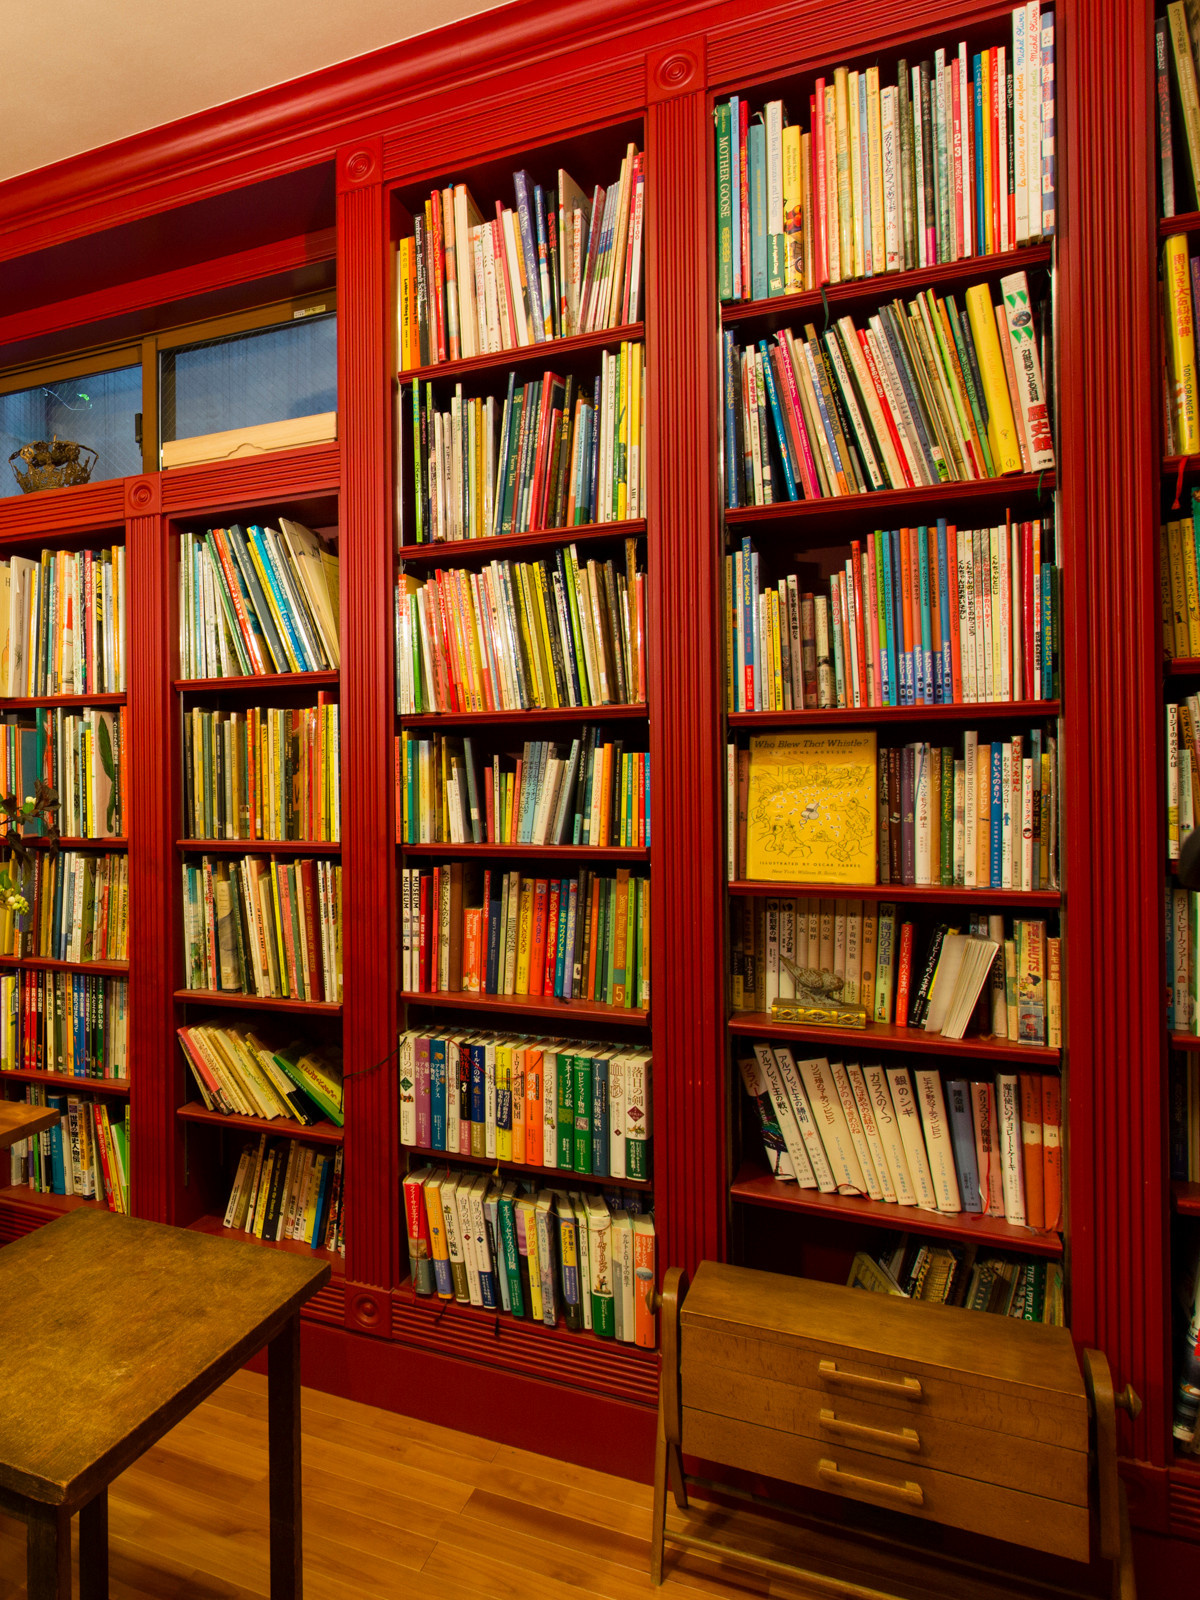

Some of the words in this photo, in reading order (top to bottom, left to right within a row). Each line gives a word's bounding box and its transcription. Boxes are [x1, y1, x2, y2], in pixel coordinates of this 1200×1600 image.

[719, 136, 729, 182] MOTHER
[720, 184, 731, 218] GOOSE
[413, 216, 422, 245] Rembrandt
[414, 253, 424, 283] Rembrandt
[1173, 253, 1191, 338] 思いつき大百科辞典
[810, 337, 820, 357] PETER
[817, 363, 828, 387] HUNT'S
[824, 394, 841, 436] WORKBOOK
[1183, 364, 1194, 416] 100%ORANGE
[1028, 404, 1053, 452] 歴史館
[754, 740, 775, 748] Who
[778, 739, 800, 748] Blew
[803, 739, 825, 748] That
[827, 738, 869, 748] Whistle?
[1169, 707, 1177, 767] ロージーのおさんぽ
[992, 752, 1001, 805] ももいろのきりん
[1012, 740, 1021, 793] わんぱくえほん
[617, 894, 627, 913] Seeing
[785, 913, 794, 953] 少女ソフィアの夏
[880, 921, 892, 966] 海辺の王国
[1028, 923, 1040, 972] PEANUTS
[615, 986, 623, 1001] 5
[564, 1058, 573, 1107] アネイリンの歌
[632, 1066, 643, 1106] 落日の剣
[834, 1069, 850, 1098] イタリアの
[843, 1099, 861, 1135] のぞきめがね
[870, 1072, 892, 1124] ガラスのくつ
[894, 1075, 914, 1118] 銀のシギ
[70, 1114, 81, 1163] 世界の歴史人物伝
